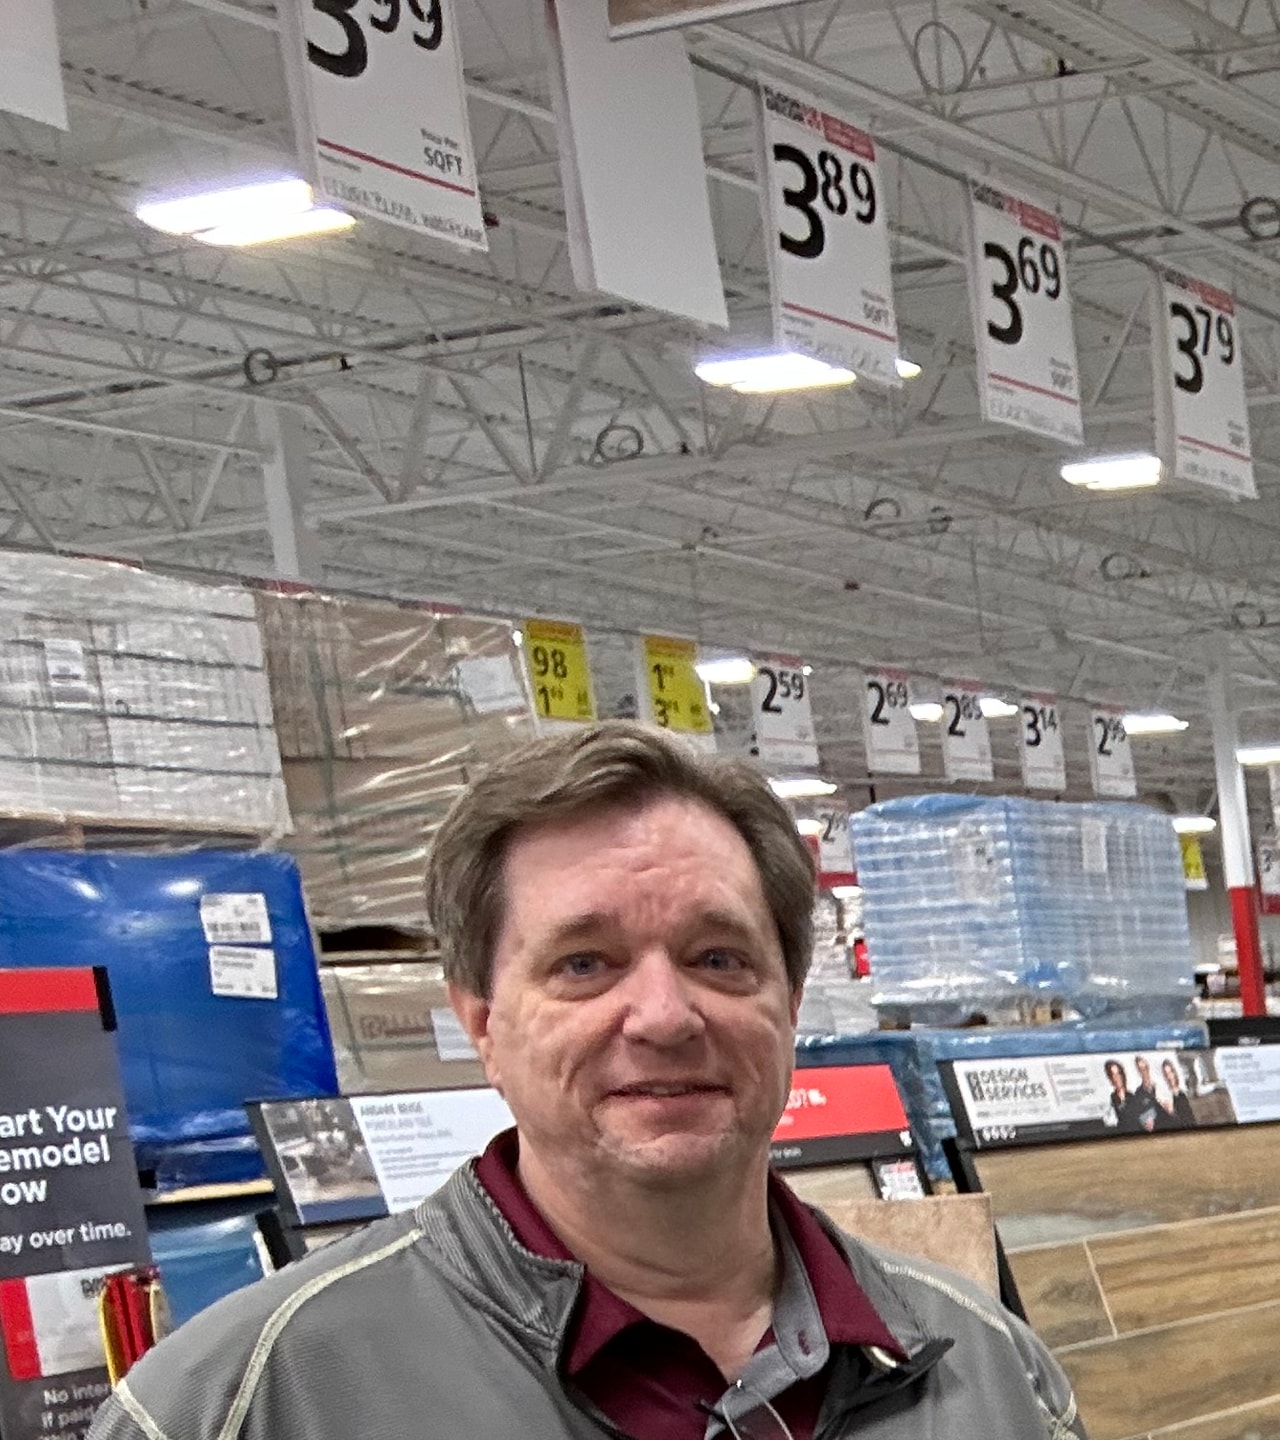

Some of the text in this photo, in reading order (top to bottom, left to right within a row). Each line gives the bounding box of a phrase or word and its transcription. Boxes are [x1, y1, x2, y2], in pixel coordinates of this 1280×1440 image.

[46, 1105, 118, 1134] Your
[29, 1228, 75, 1249] over
[79, 1222, 132, 1243] time.
[43, 1388, 69, 1406] No
